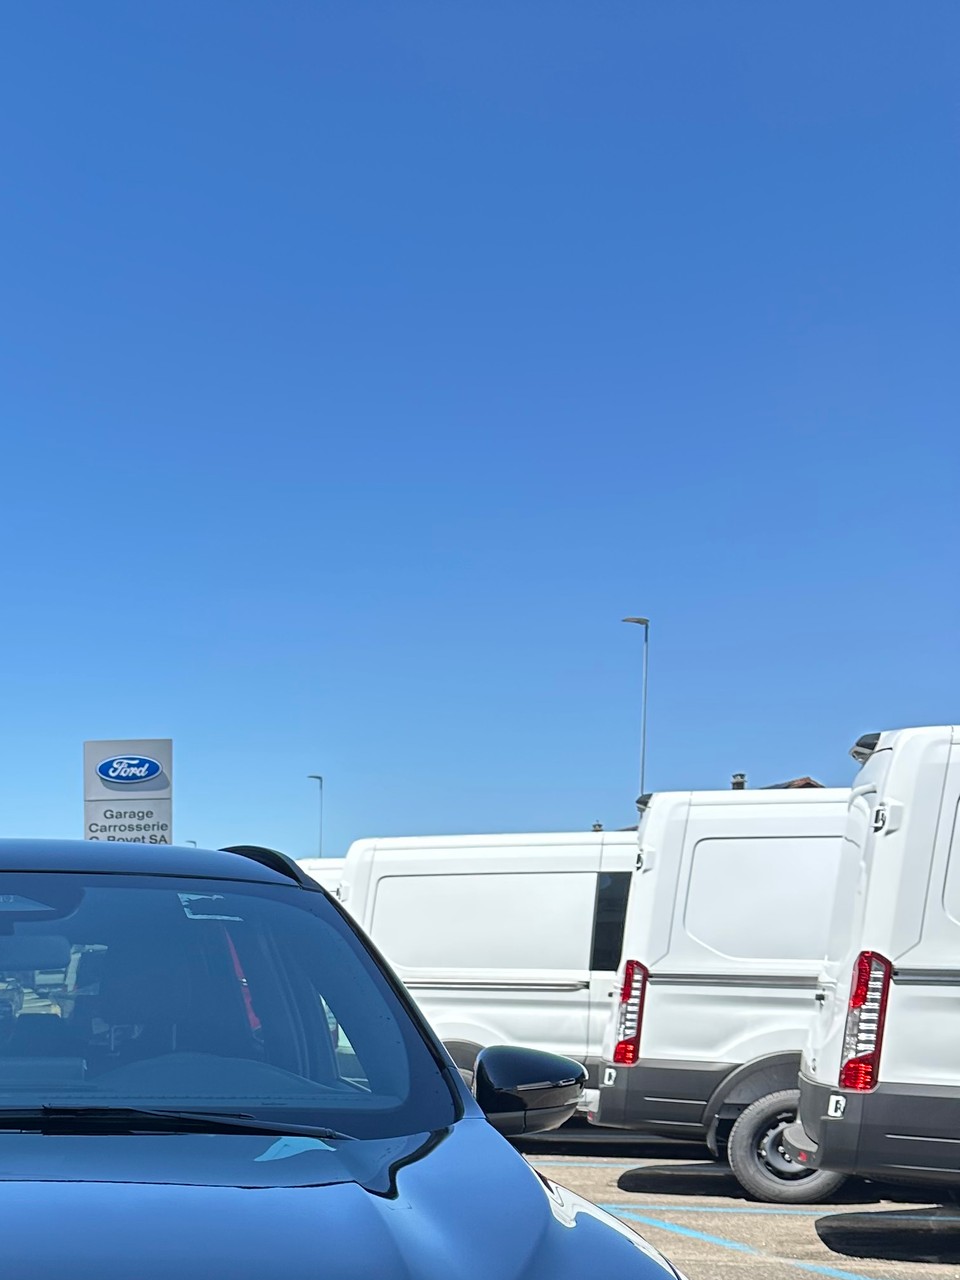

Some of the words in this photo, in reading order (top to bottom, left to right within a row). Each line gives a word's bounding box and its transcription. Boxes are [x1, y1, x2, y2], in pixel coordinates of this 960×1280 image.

[108, 759, 149, 777] Ford
[103, 809, 154, 821] Garage
[88, 821, 169, 833] Carrosserie
[149, 834, 168, 845] SA
